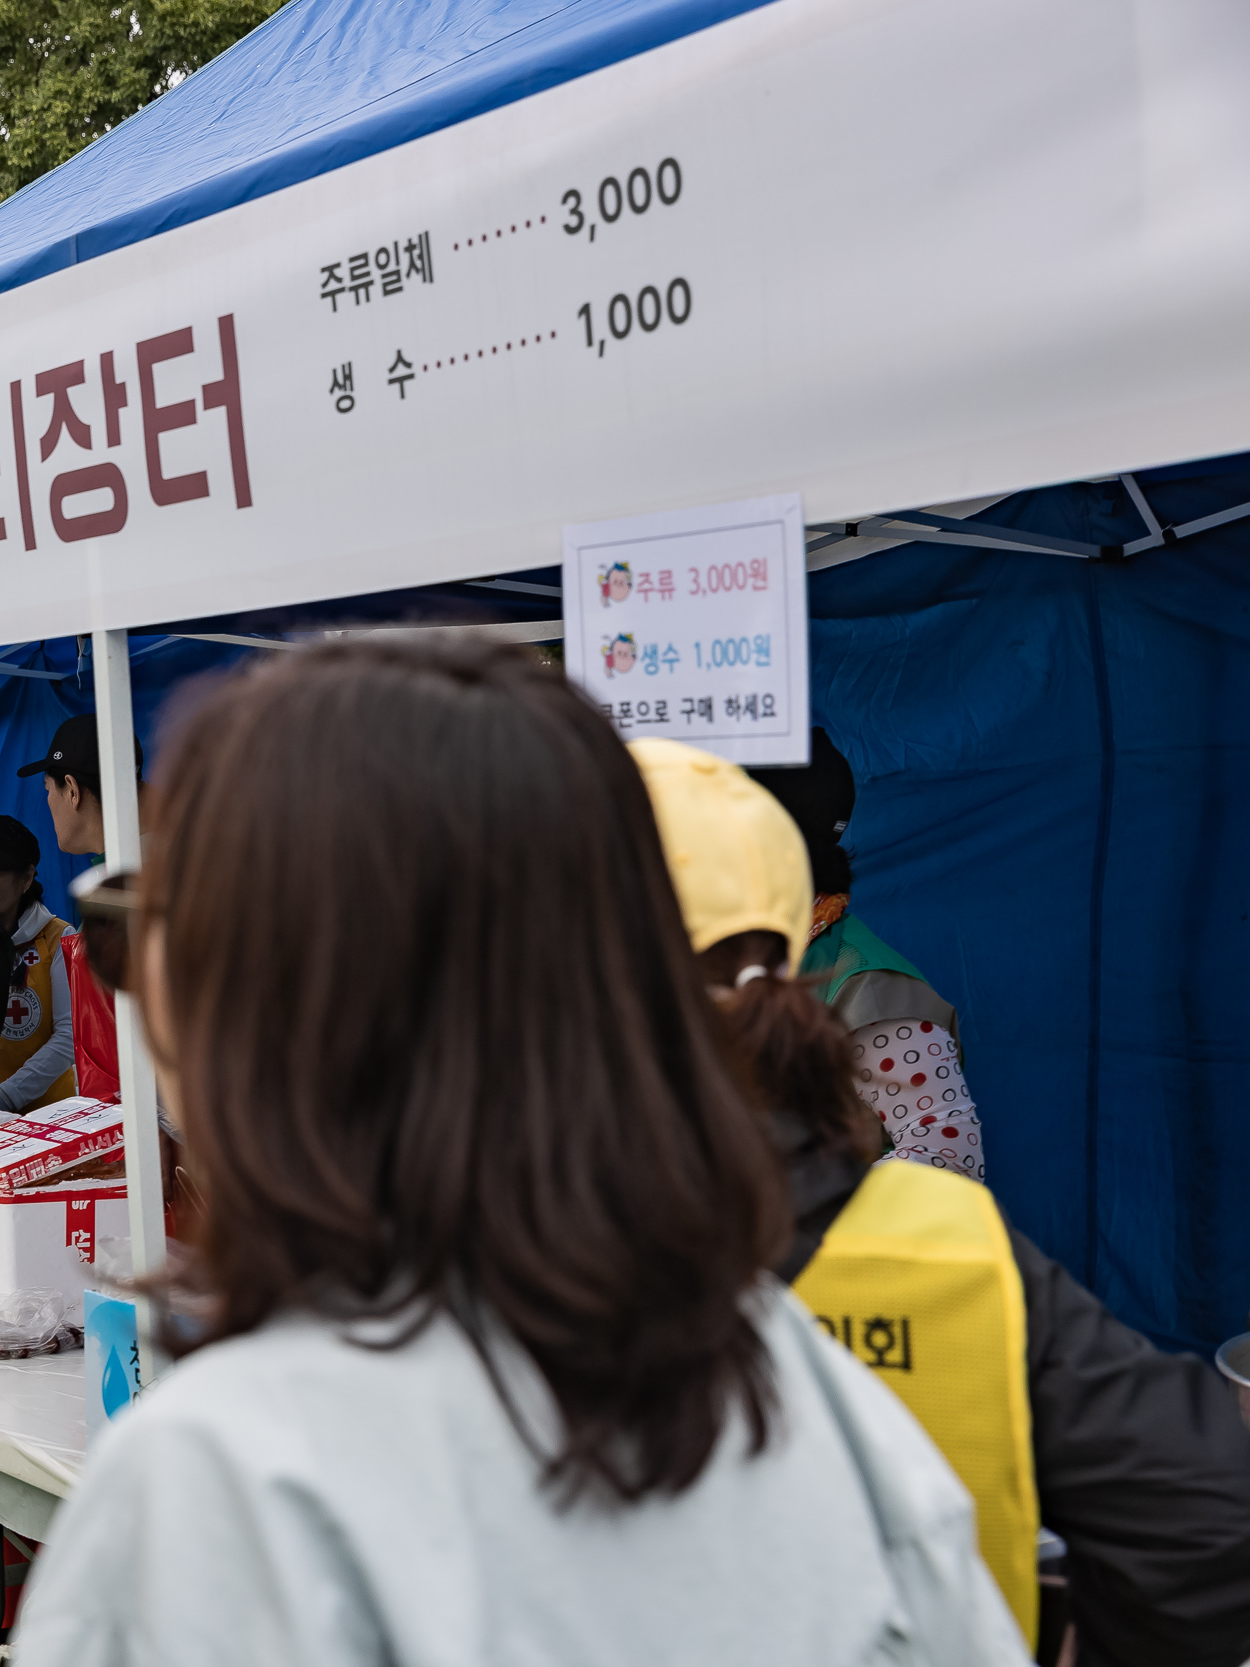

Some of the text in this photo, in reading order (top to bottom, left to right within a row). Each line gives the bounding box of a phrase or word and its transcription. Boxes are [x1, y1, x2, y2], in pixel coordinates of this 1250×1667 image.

[319, 156, 682, 313] 주류일체 3,000
[329, 277, 692, 414] 생 수 1,000
[636, 557, 769, 603] 주류 3,000원
[640, 633, 772, 676] 생수 1,000원
[679, 697, 715, 725] 구매
[724, 692, 777, 722] 하세요
[24, 991, 39, 1011] CROSS
[3, 1022, 36, 1037] 한적십자사
